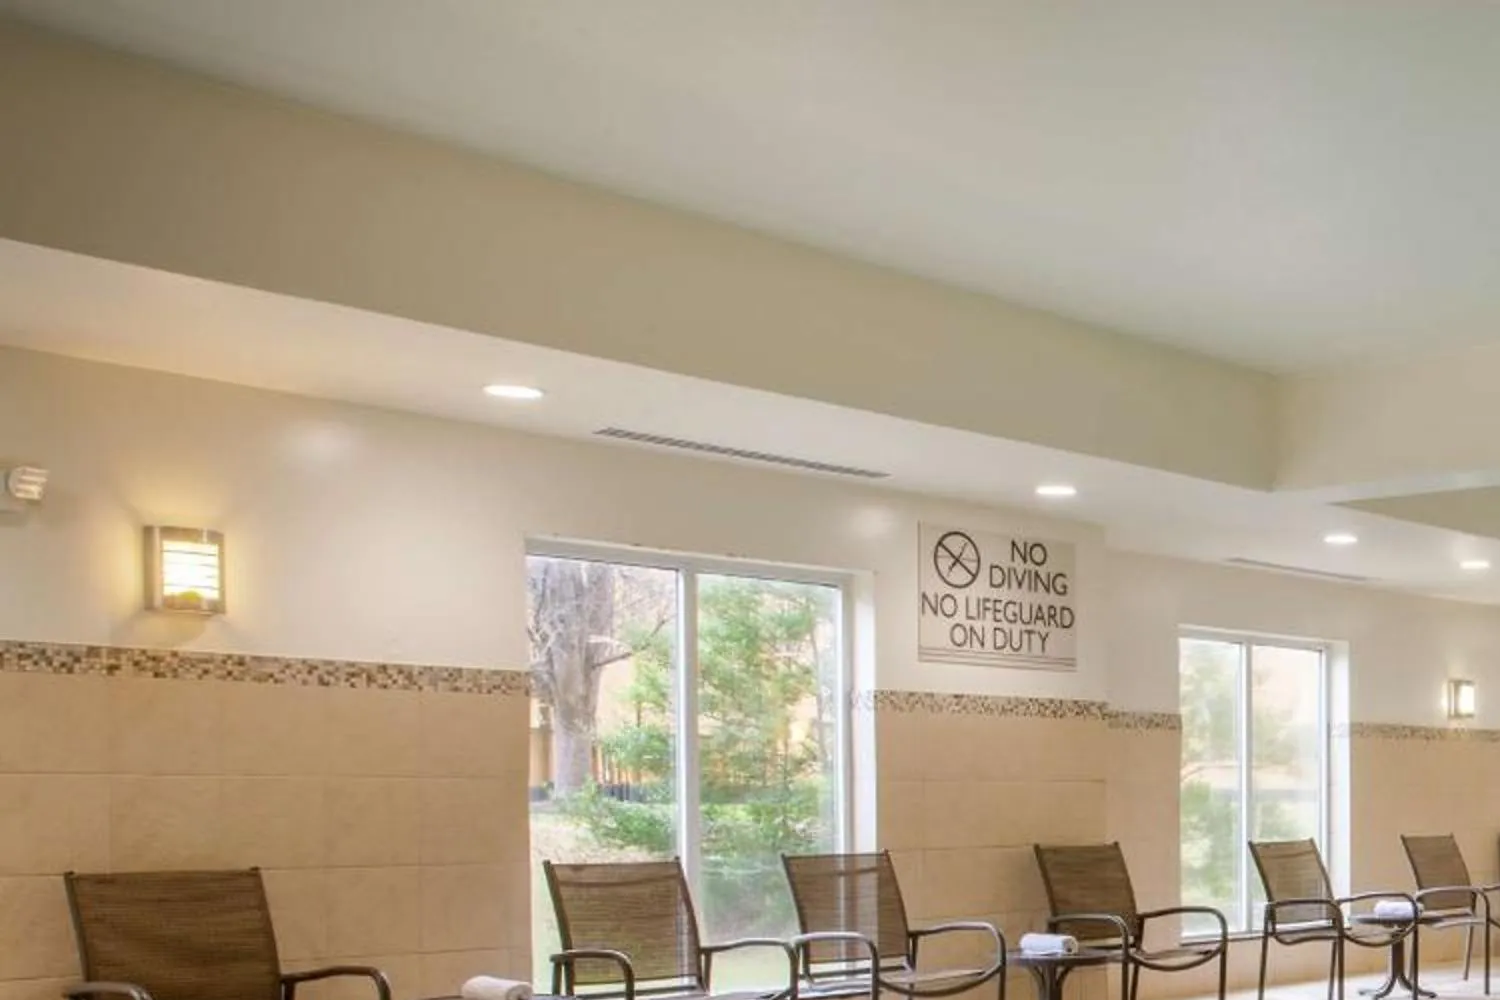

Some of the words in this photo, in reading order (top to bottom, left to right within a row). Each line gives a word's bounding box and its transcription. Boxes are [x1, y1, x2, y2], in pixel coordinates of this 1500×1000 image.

[1011, 540, 1047, 566] NO
[989, 565, 1068, 595] DIVING
[921, 592, 958, 618] NO
[965, 596, 1075, 629] LIFEGUARD
[950, 623, 985, 648] ON
[993, 627, 1049, 653] DUTY
